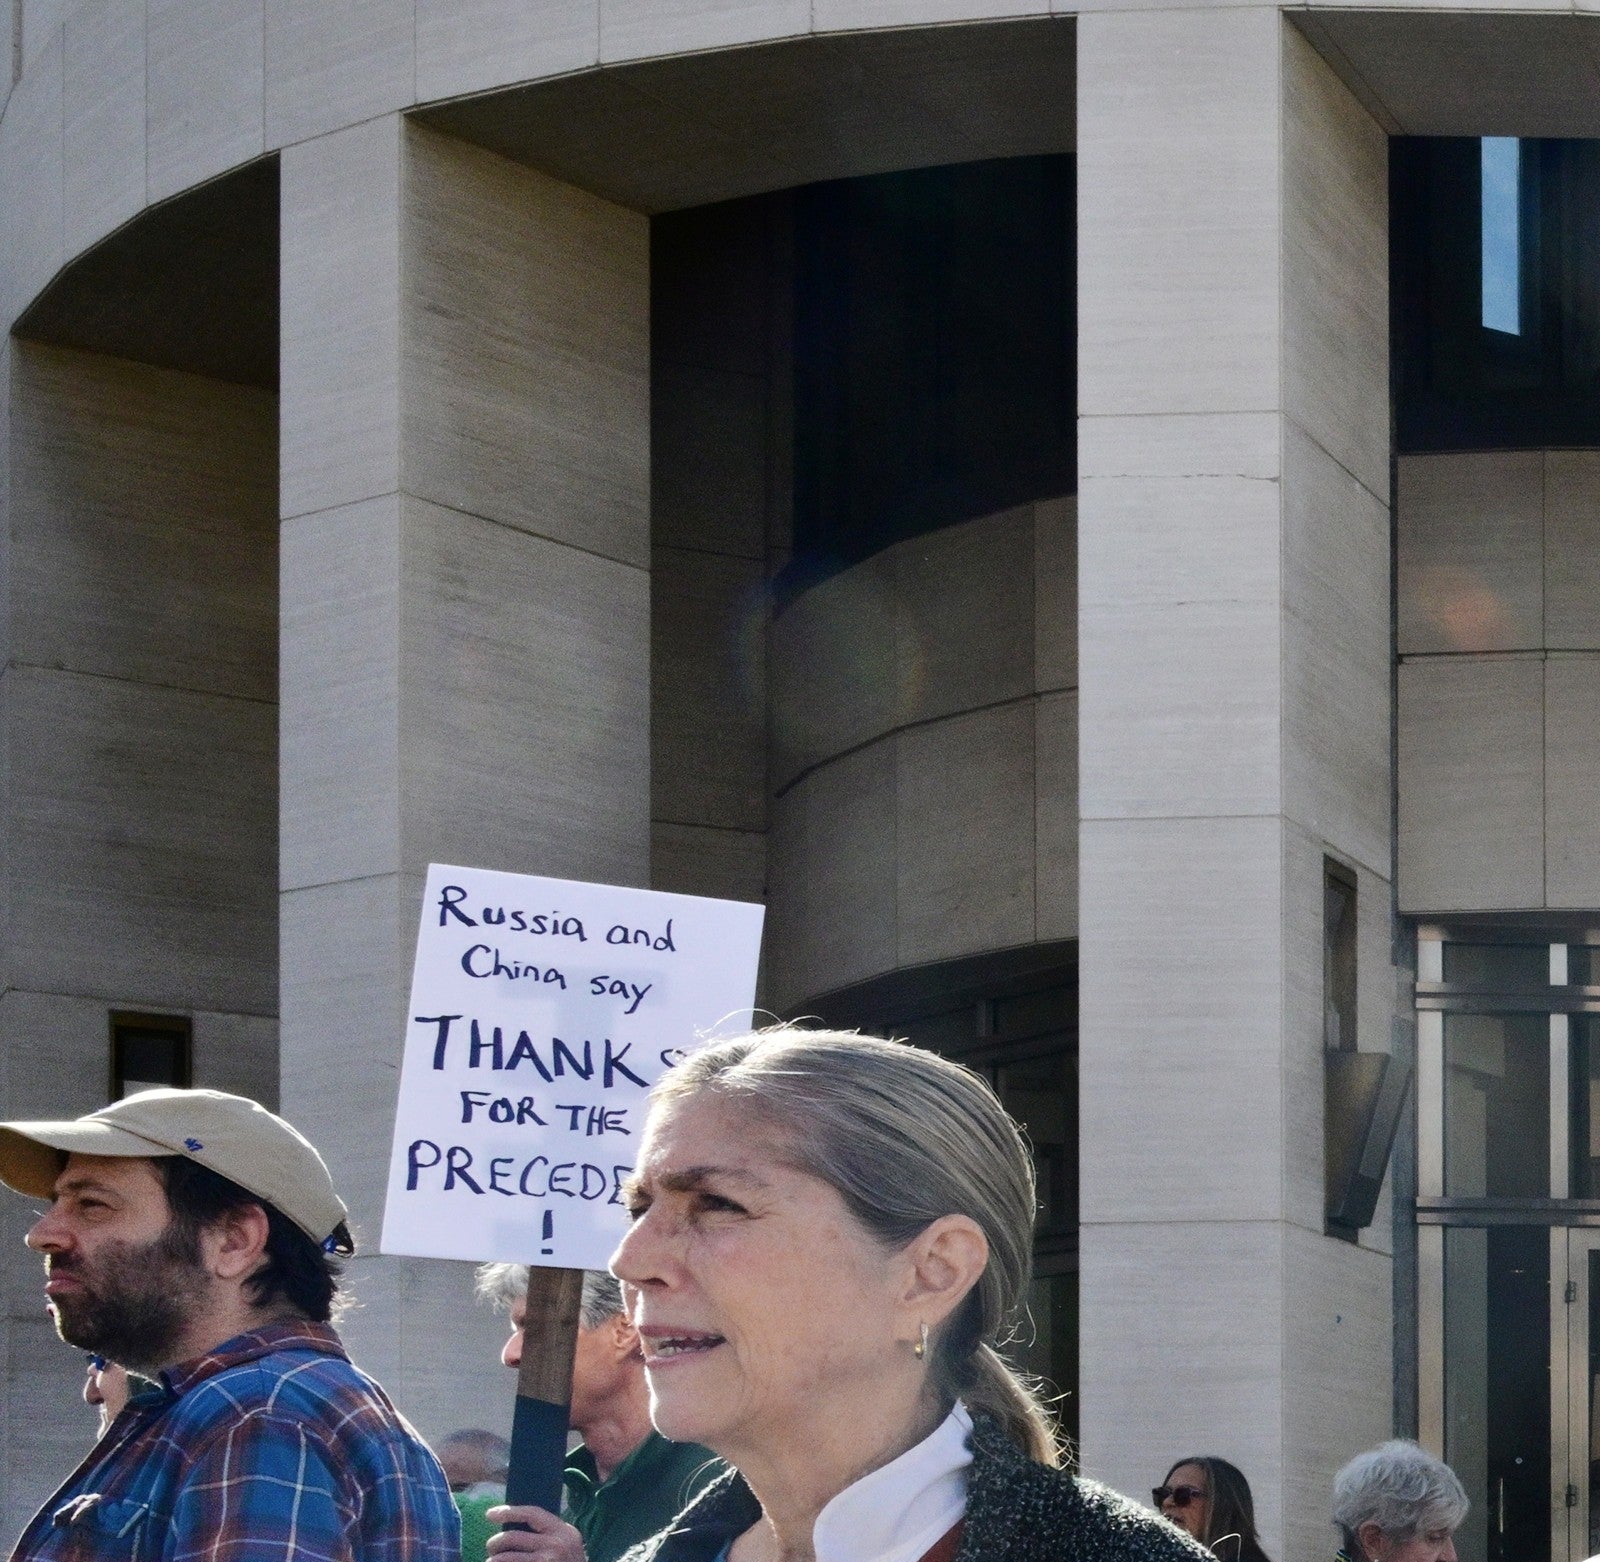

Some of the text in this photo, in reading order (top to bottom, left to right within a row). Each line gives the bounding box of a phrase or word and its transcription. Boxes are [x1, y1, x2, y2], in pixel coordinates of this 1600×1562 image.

[438, 886, 677, 953] Russia and
[461, 944, 652, 1014] China say
[461, 1091, 631, 1136] FOR THE
[541, 1210, 553, 1255] !
